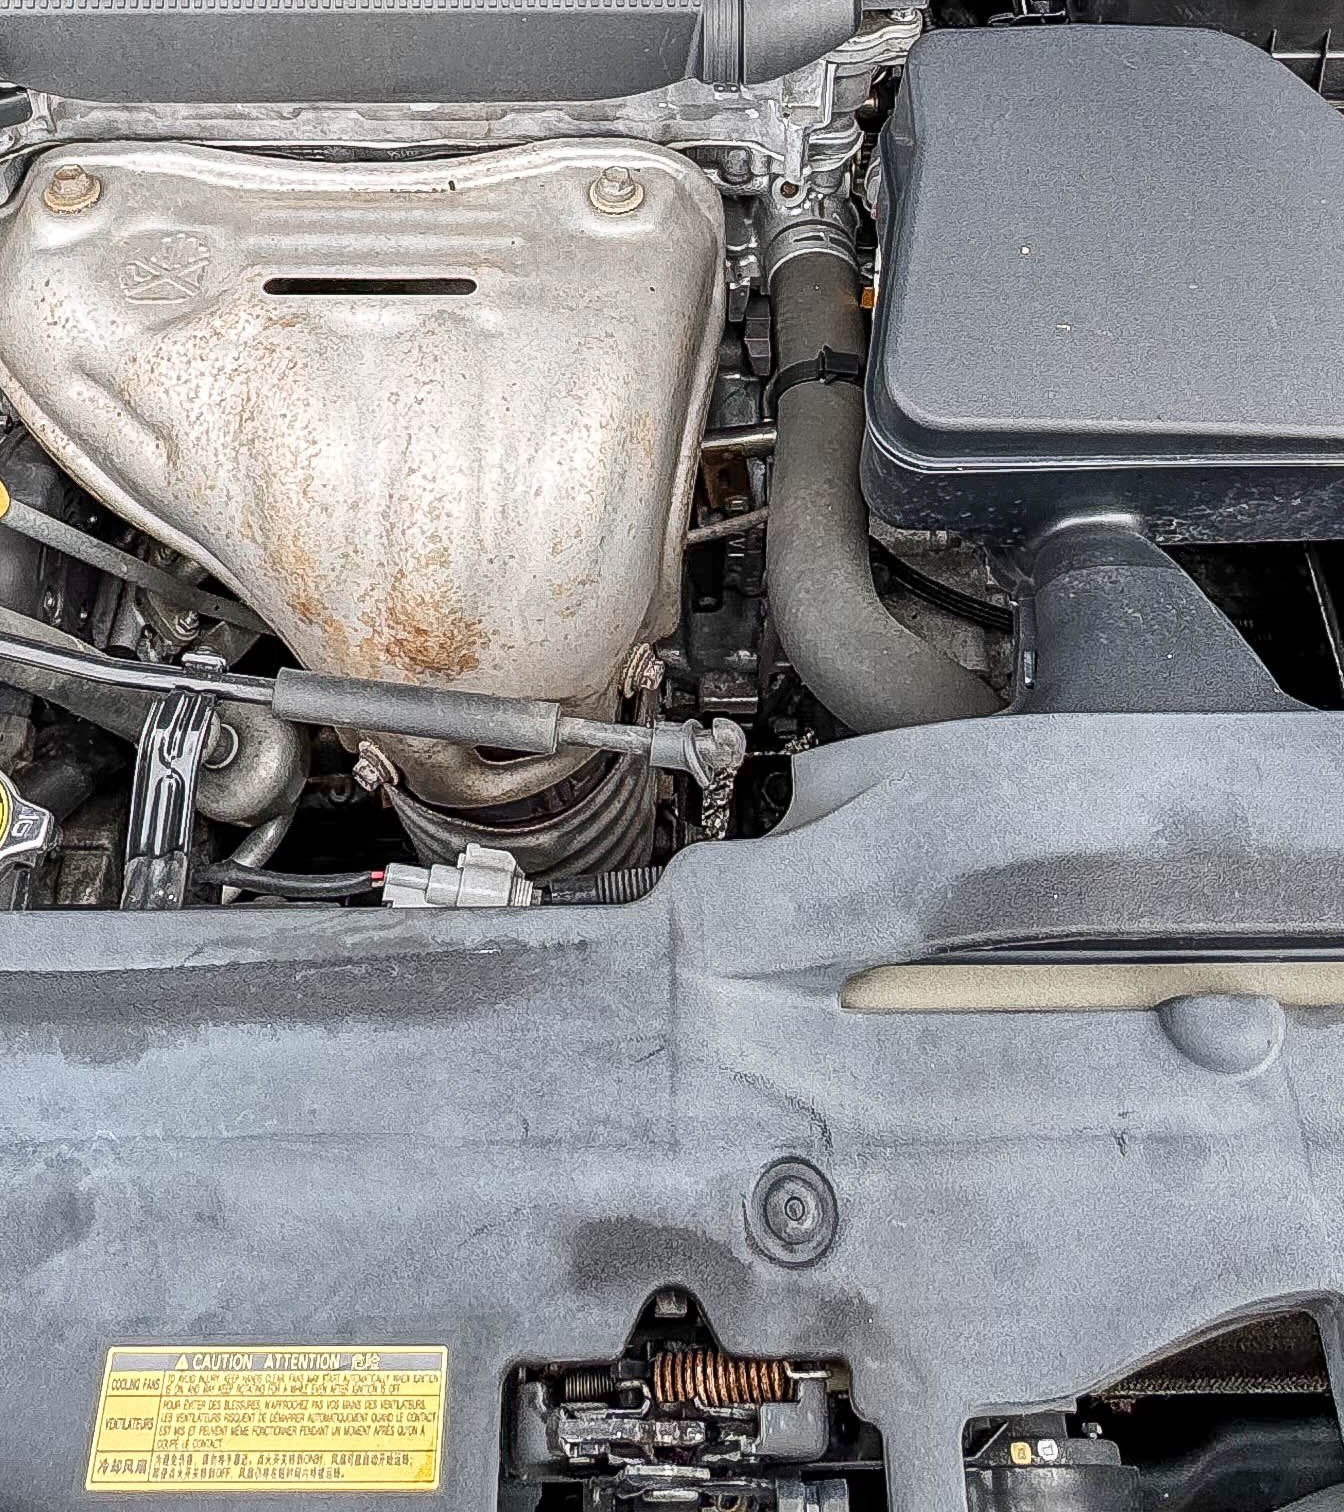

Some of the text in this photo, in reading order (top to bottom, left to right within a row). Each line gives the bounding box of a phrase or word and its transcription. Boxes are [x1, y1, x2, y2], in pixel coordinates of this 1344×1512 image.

[192, 1353, 254, 1370] CAUTION
[264, 1353, 341, 1370] ATTENTION
[111, 1378, 161, 1390] COOLING FANS
